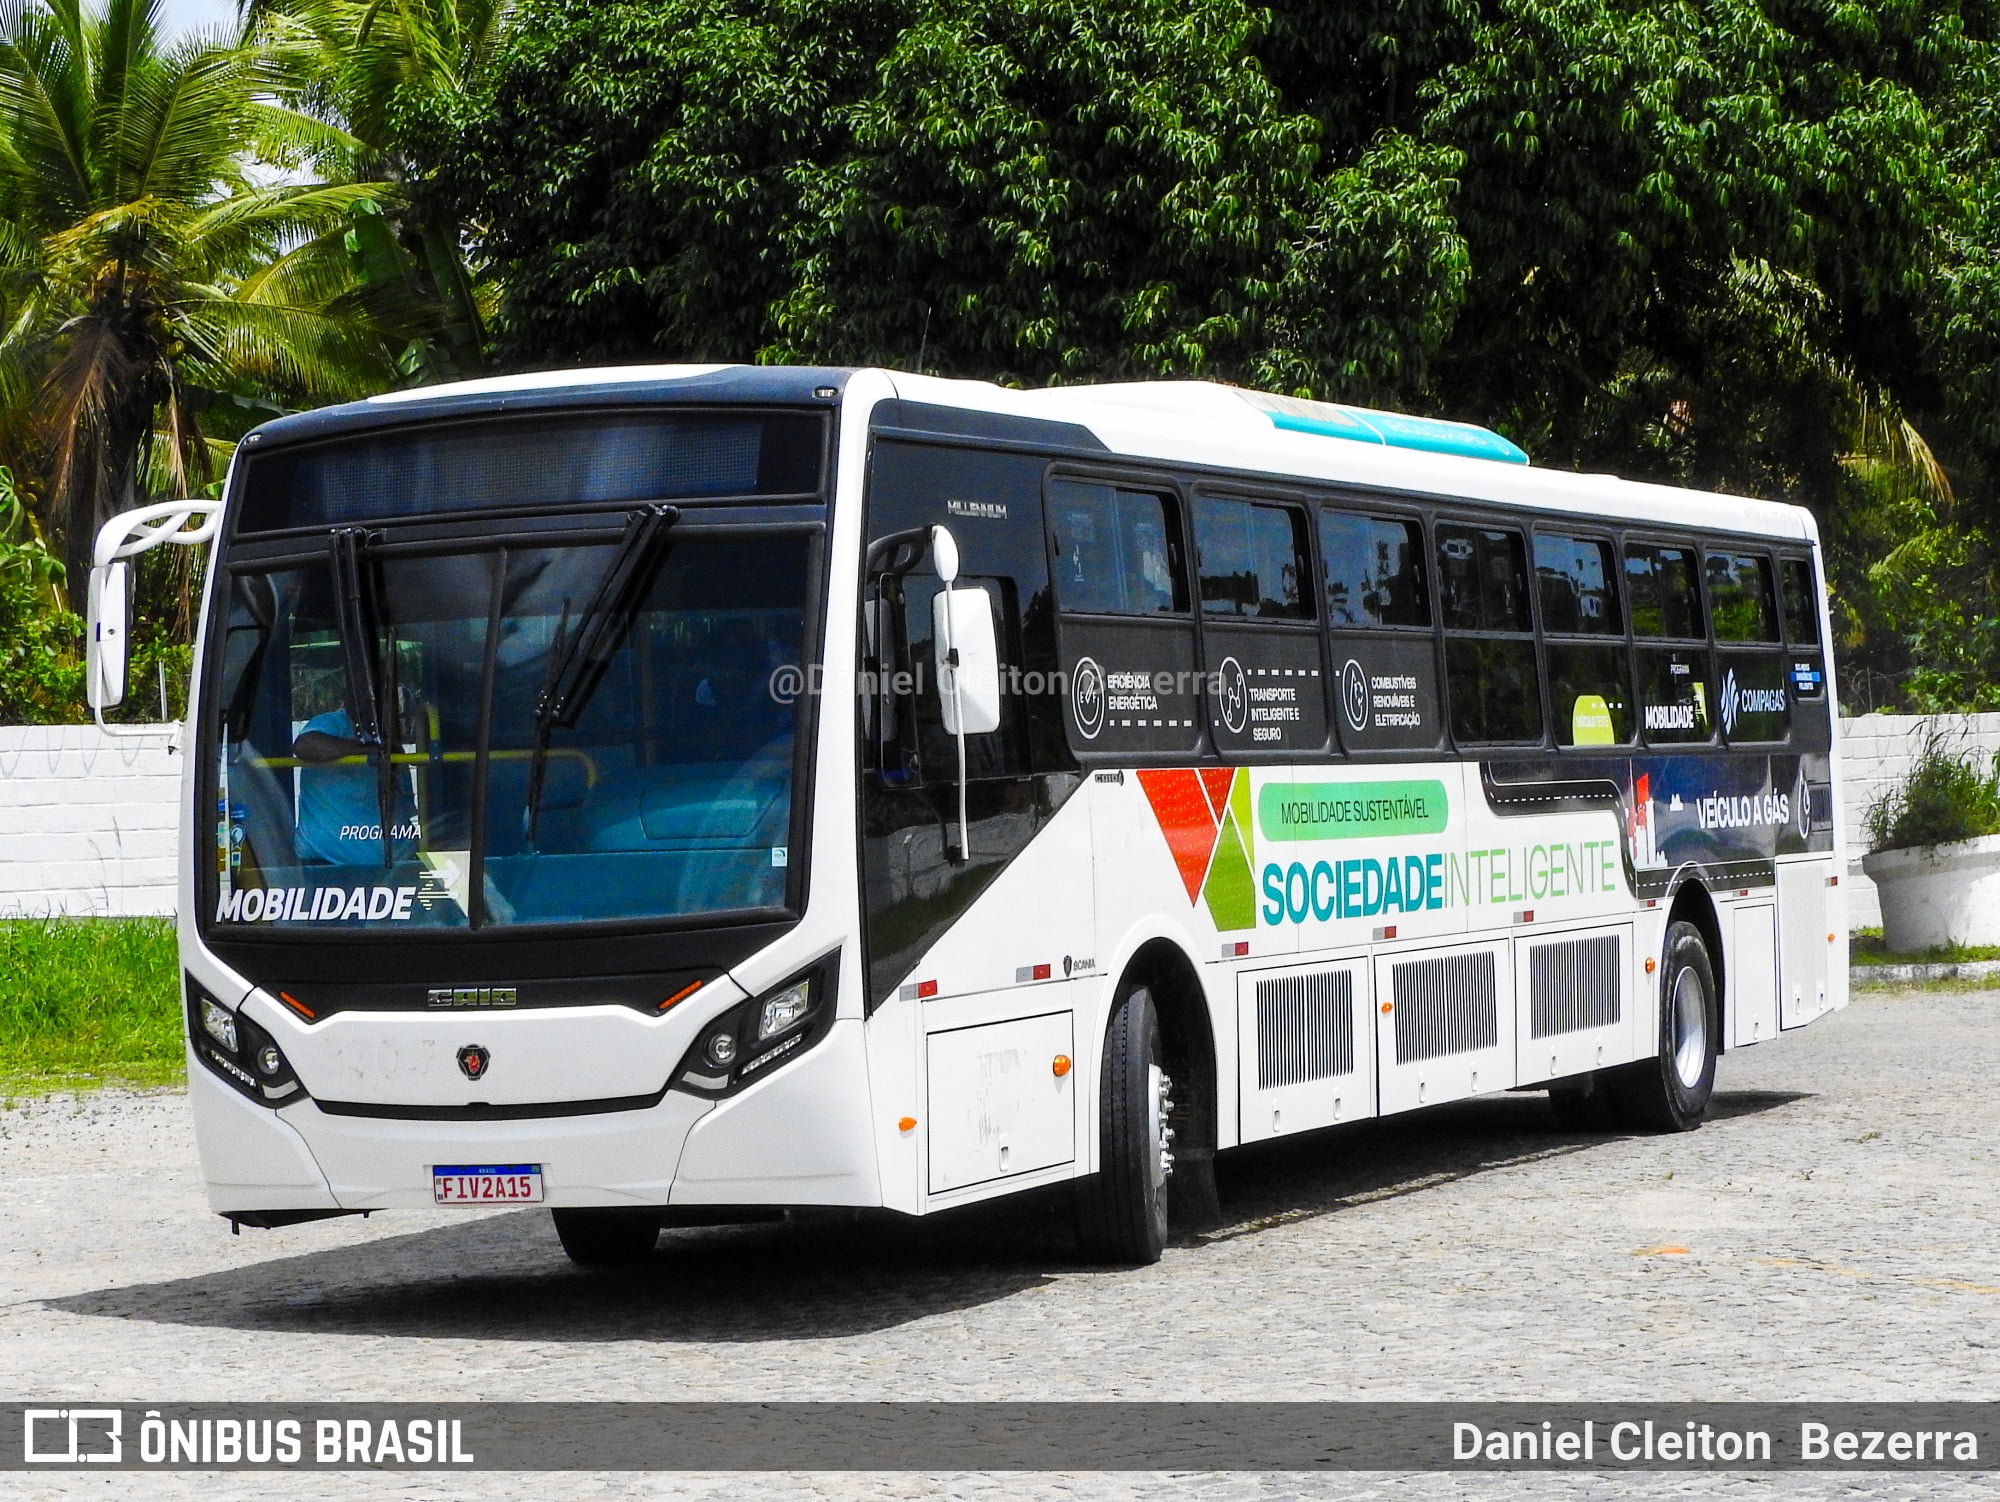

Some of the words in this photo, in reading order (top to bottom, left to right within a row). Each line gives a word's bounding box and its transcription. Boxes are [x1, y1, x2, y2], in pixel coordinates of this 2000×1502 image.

[1107, 672, 1151, 689] EFICIÊNCIA
[1371, 674, 1417, 690] COMBUSTÍVEIS
[1108, 693, 1159, 710] ENERGÉTICA
[1249, 688, 1296, 701] TRANSPORTE
[1373, 692, 1410, 708] RENOVÁVEIS
[1410, 695, 1416, 708] E
[1741, 688, 1785, 712] COMPAGAS
[1251, 707, 1295, 721] INTELIGENTE
[1294, 707, 1300, 721] E
[1375, 711, 1421, 729] ELETRIFICAÇÃO
[1645, 705, 1695, 729] MOBILIDADE
[1253, 727, 1282, 741] SEGURO
[1281, 801, 1350, 824] MOBILIDADE
[1353, 794, 1429, 822] SUSTENTÁVEL
[1696, 790, 1751, 829] VEÍCULO
[1753, 796, 1763, 826] A
[1763, 787, 1790, 825] GÁS
[1262, 853, 1443, 927] SOCIEDADE
[1443, 840, 1616, 907] INTELIGENTE
[215, 886, 416, 923] MOBILIDADE
[442, 1176, 531, 1199] FIV2A15
